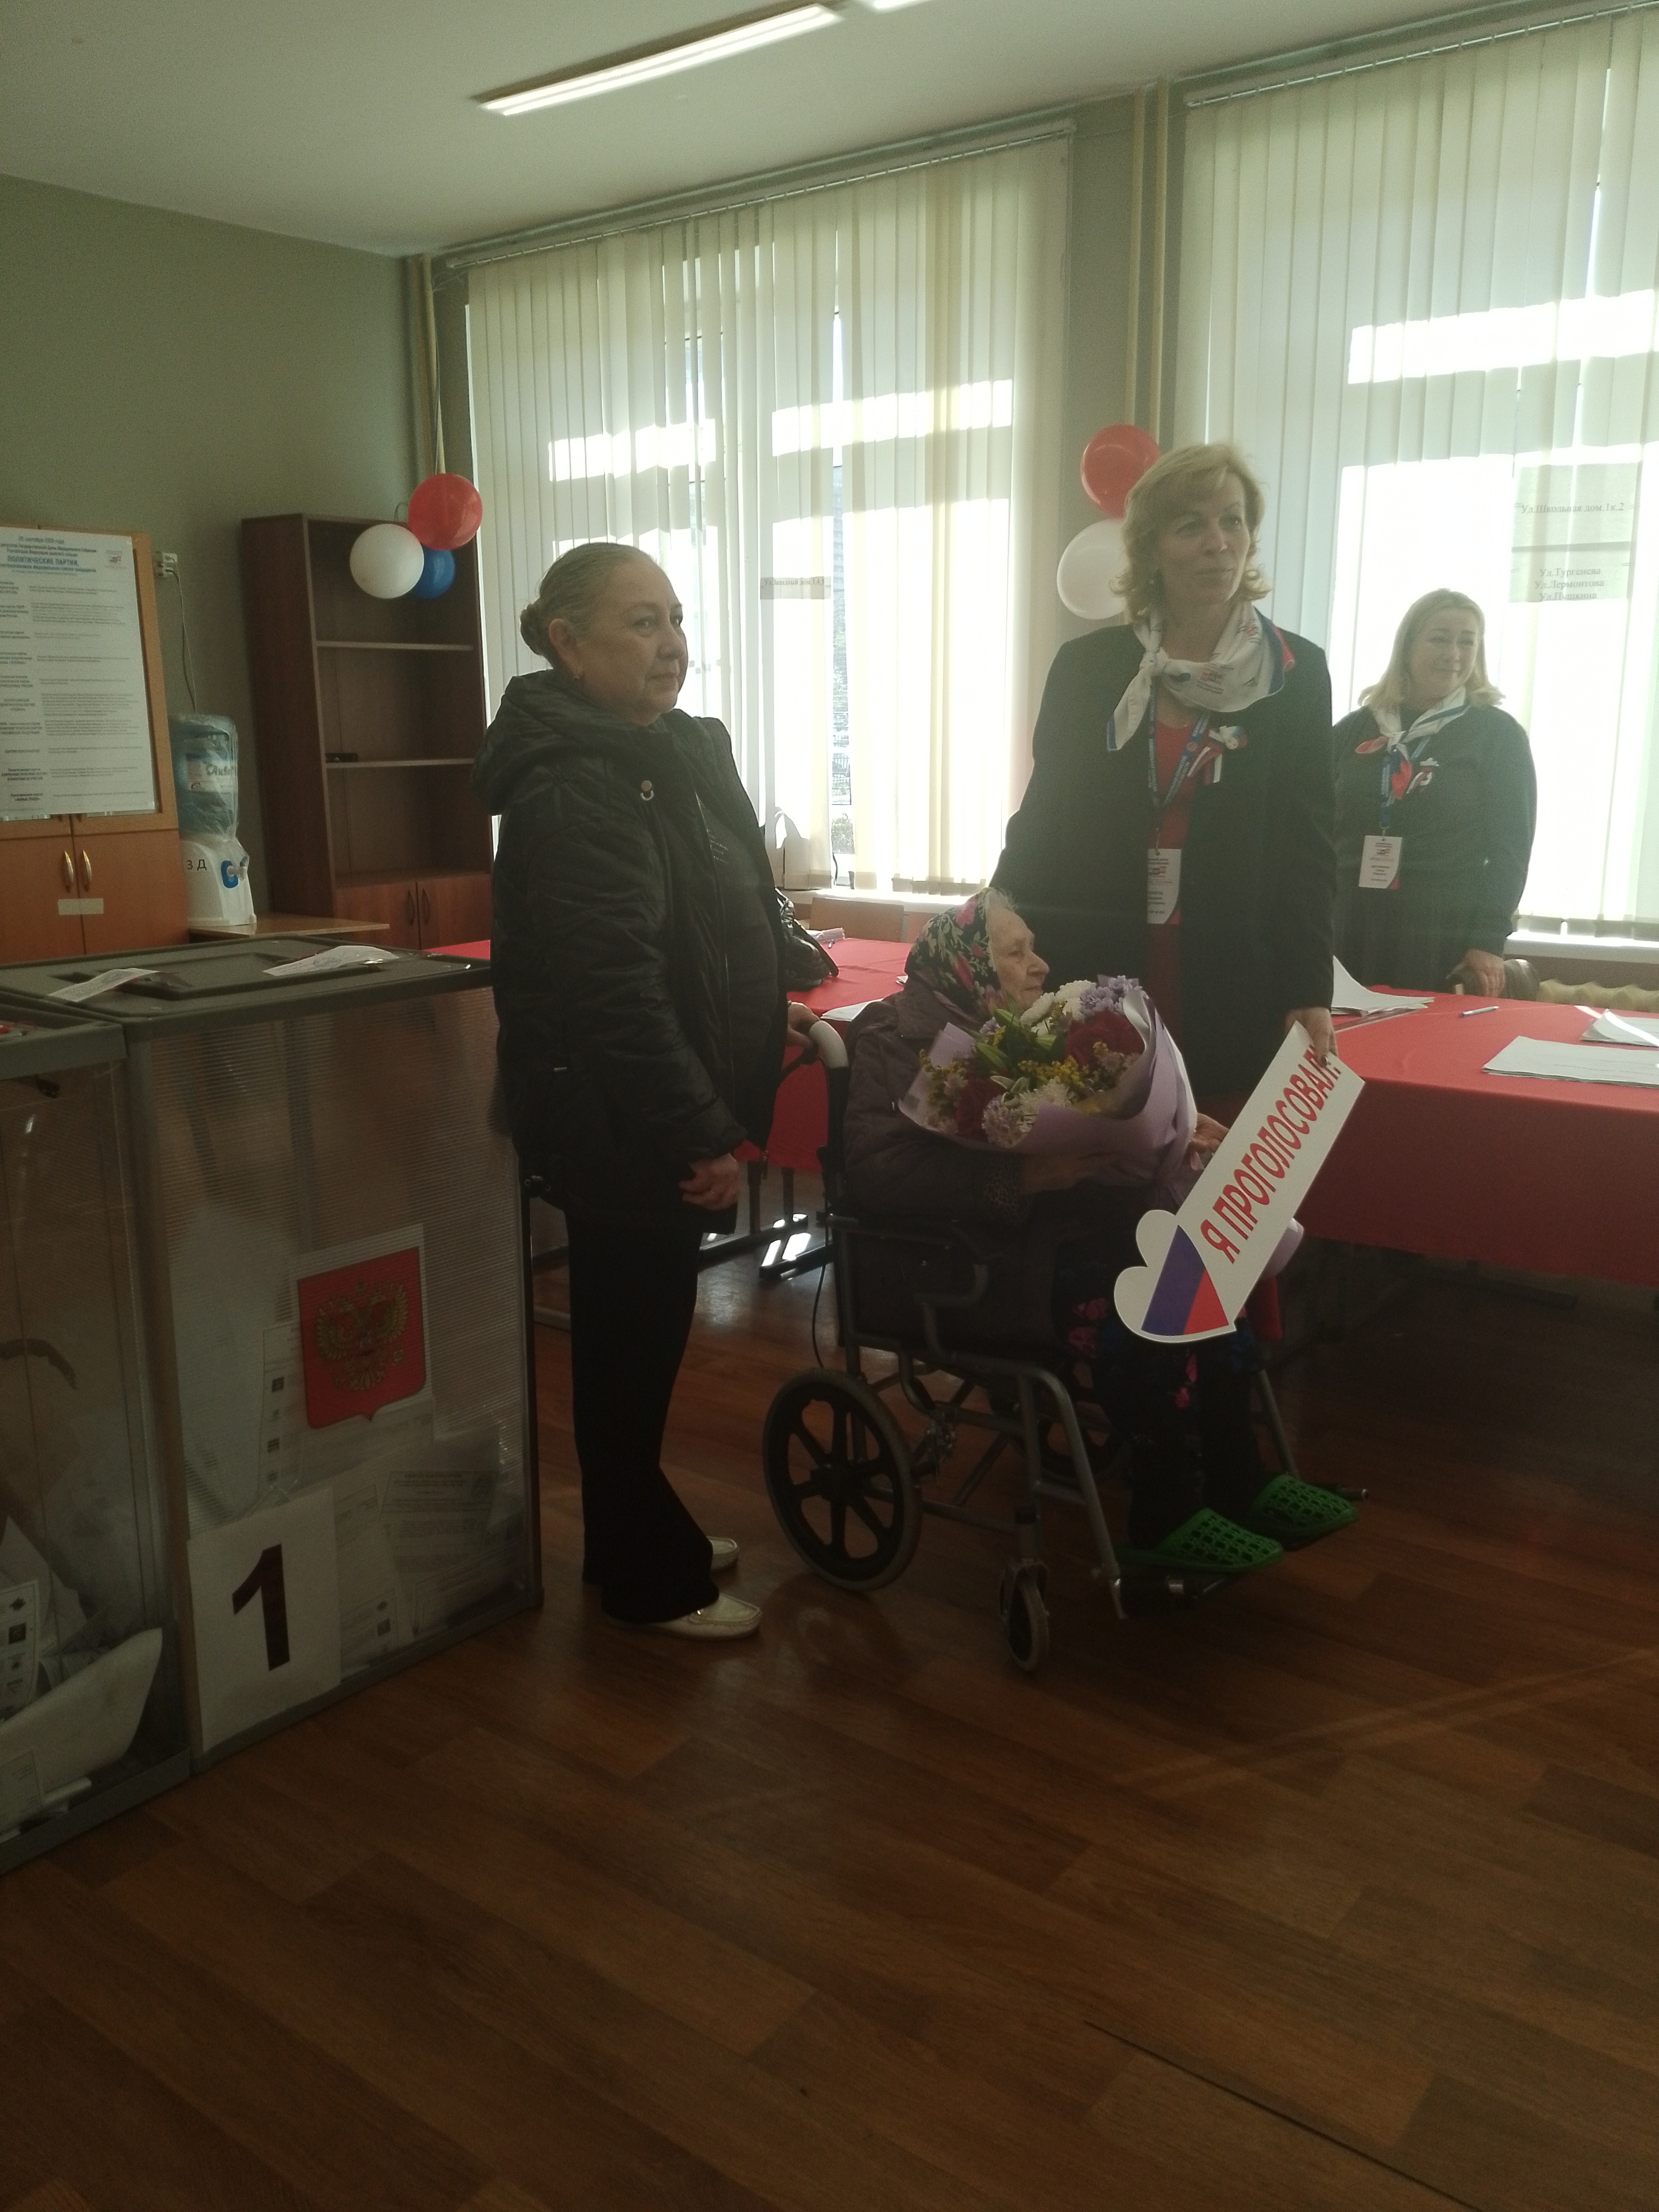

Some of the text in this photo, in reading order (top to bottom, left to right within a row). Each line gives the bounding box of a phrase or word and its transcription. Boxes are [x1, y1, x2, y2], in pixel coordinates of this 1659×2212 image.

[1522, 505, 1581, 513] Ул.Школьная
[1540, 568, 1601, 577] Ул.Тургенева
[1535, 580, 1604, 590] Ул.Лермонтова
[1201, 1220, 1241, 1264] Я
[232, 1544, 289, 1672] 1
